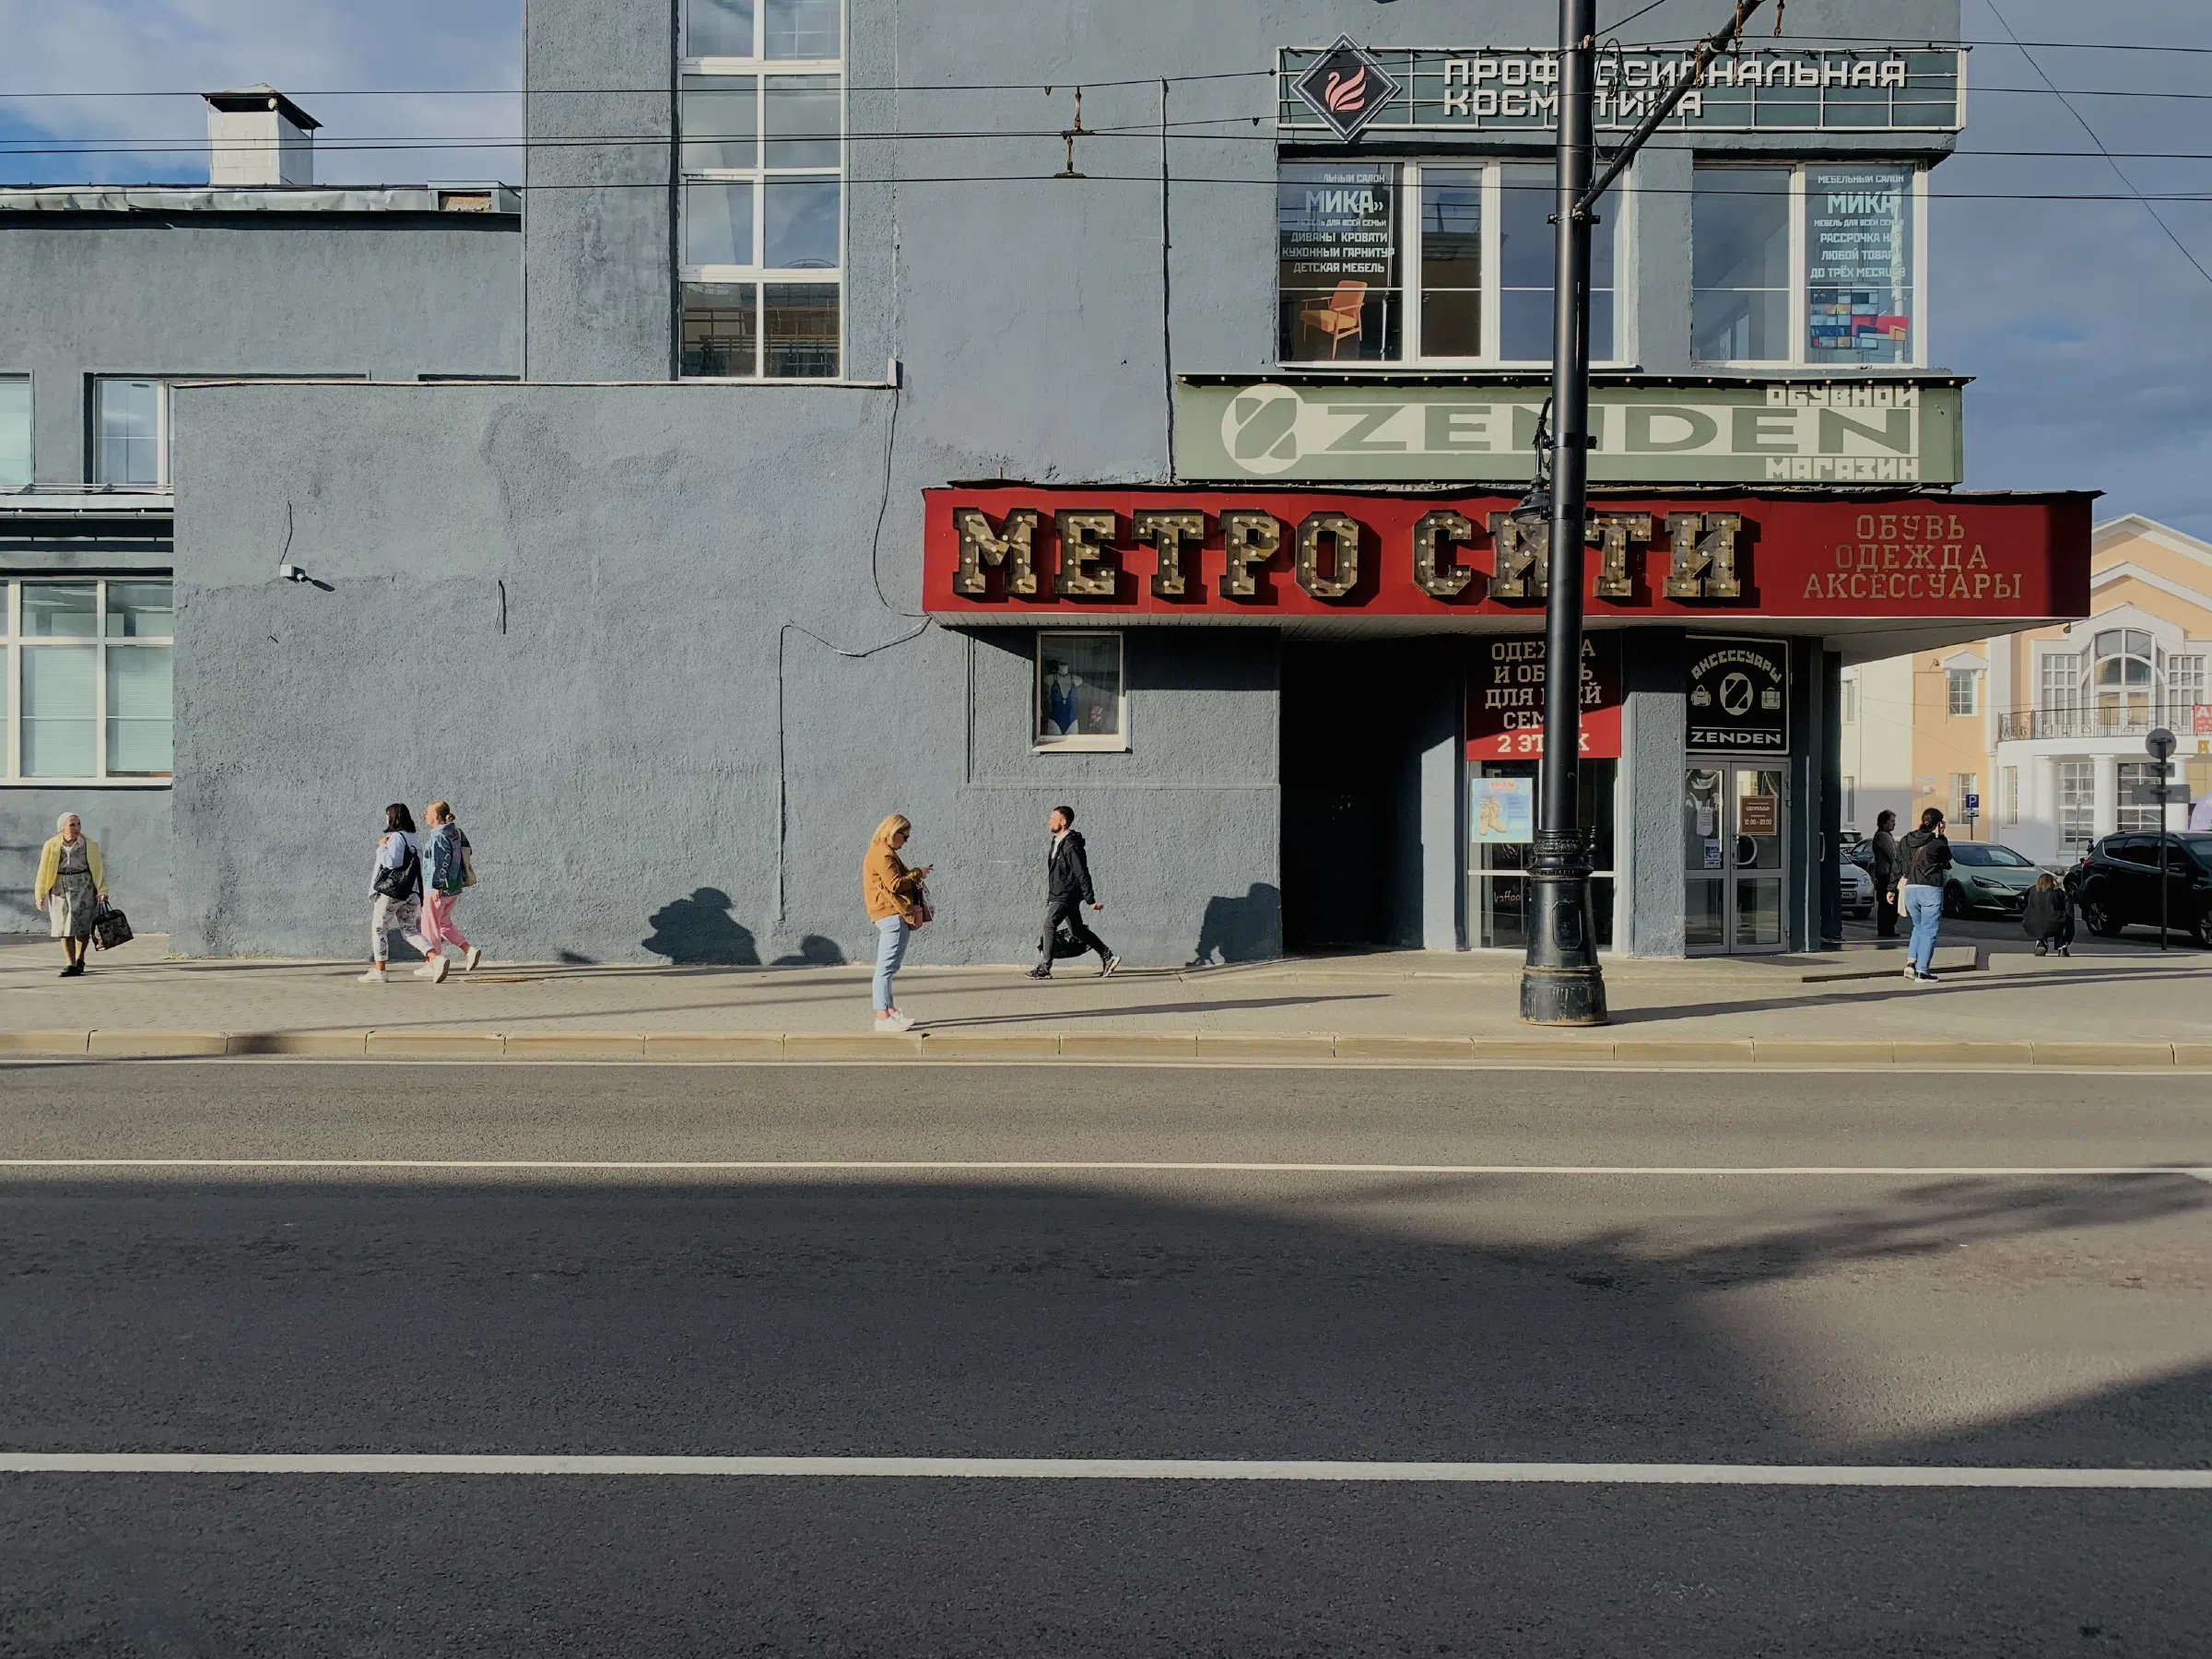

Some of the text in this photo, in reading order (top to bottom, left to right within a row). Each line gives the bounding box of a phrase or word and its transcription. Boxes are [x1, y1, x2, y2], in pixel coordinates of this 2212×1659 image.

[1444, 57, 1906, 88] ПРОФССИОНАЛЬНАЯ
[1444, 89, 1701, 117] КОСМТИКА
[1356, 174, 1385, 182] САЛОН
[1875, 175, 1904, 183] САЛОН
[1326, 219, 1341, 228] ДЛЯ
[1843, 219, 1858, 228] ДЛЯ
[1290, 232, 1388, 242] ДИВАНЫ КРОВАТИ
[1819, 233, 1880, 243] РАССРОЧКА
[1342, 248, 1394, 258] ГАРНИТУР
[1821, 248, 1859, 261] ЛЮБОЙ
[1293, 263, 1385, 274] ДЕТСКАЯ МЕБЕЛЬ
[1810, 268, 1825, 279] ДО
[1828, 265, 1854, 277] ТРЁХ
[1324, 405, 1911, 454] ZENDEN
[1766, 457, 1919, 480] МАГАЗИН
[1856, 514, 1966, 540] ОБУВЬ
[952, 506, 1742, 598] МЕТРО СИТИ
[1835, 544, 1989, 573] ОДЕЖДА
[1802, 572, 2022, 599] АКСЕССУАРЫ
[1493, 663, 1594, 684] И ОБЬ
[1690, 650, 1783, 683] АКСЕССУАРЫ
[1485, 688, 1534, 710] ДЛЯ
[1497, 733, 1590, 753] 2 ЭТ
[1690, 731, 1782, 745] ZENDEN
[1969, 794, 1977, 807] P
